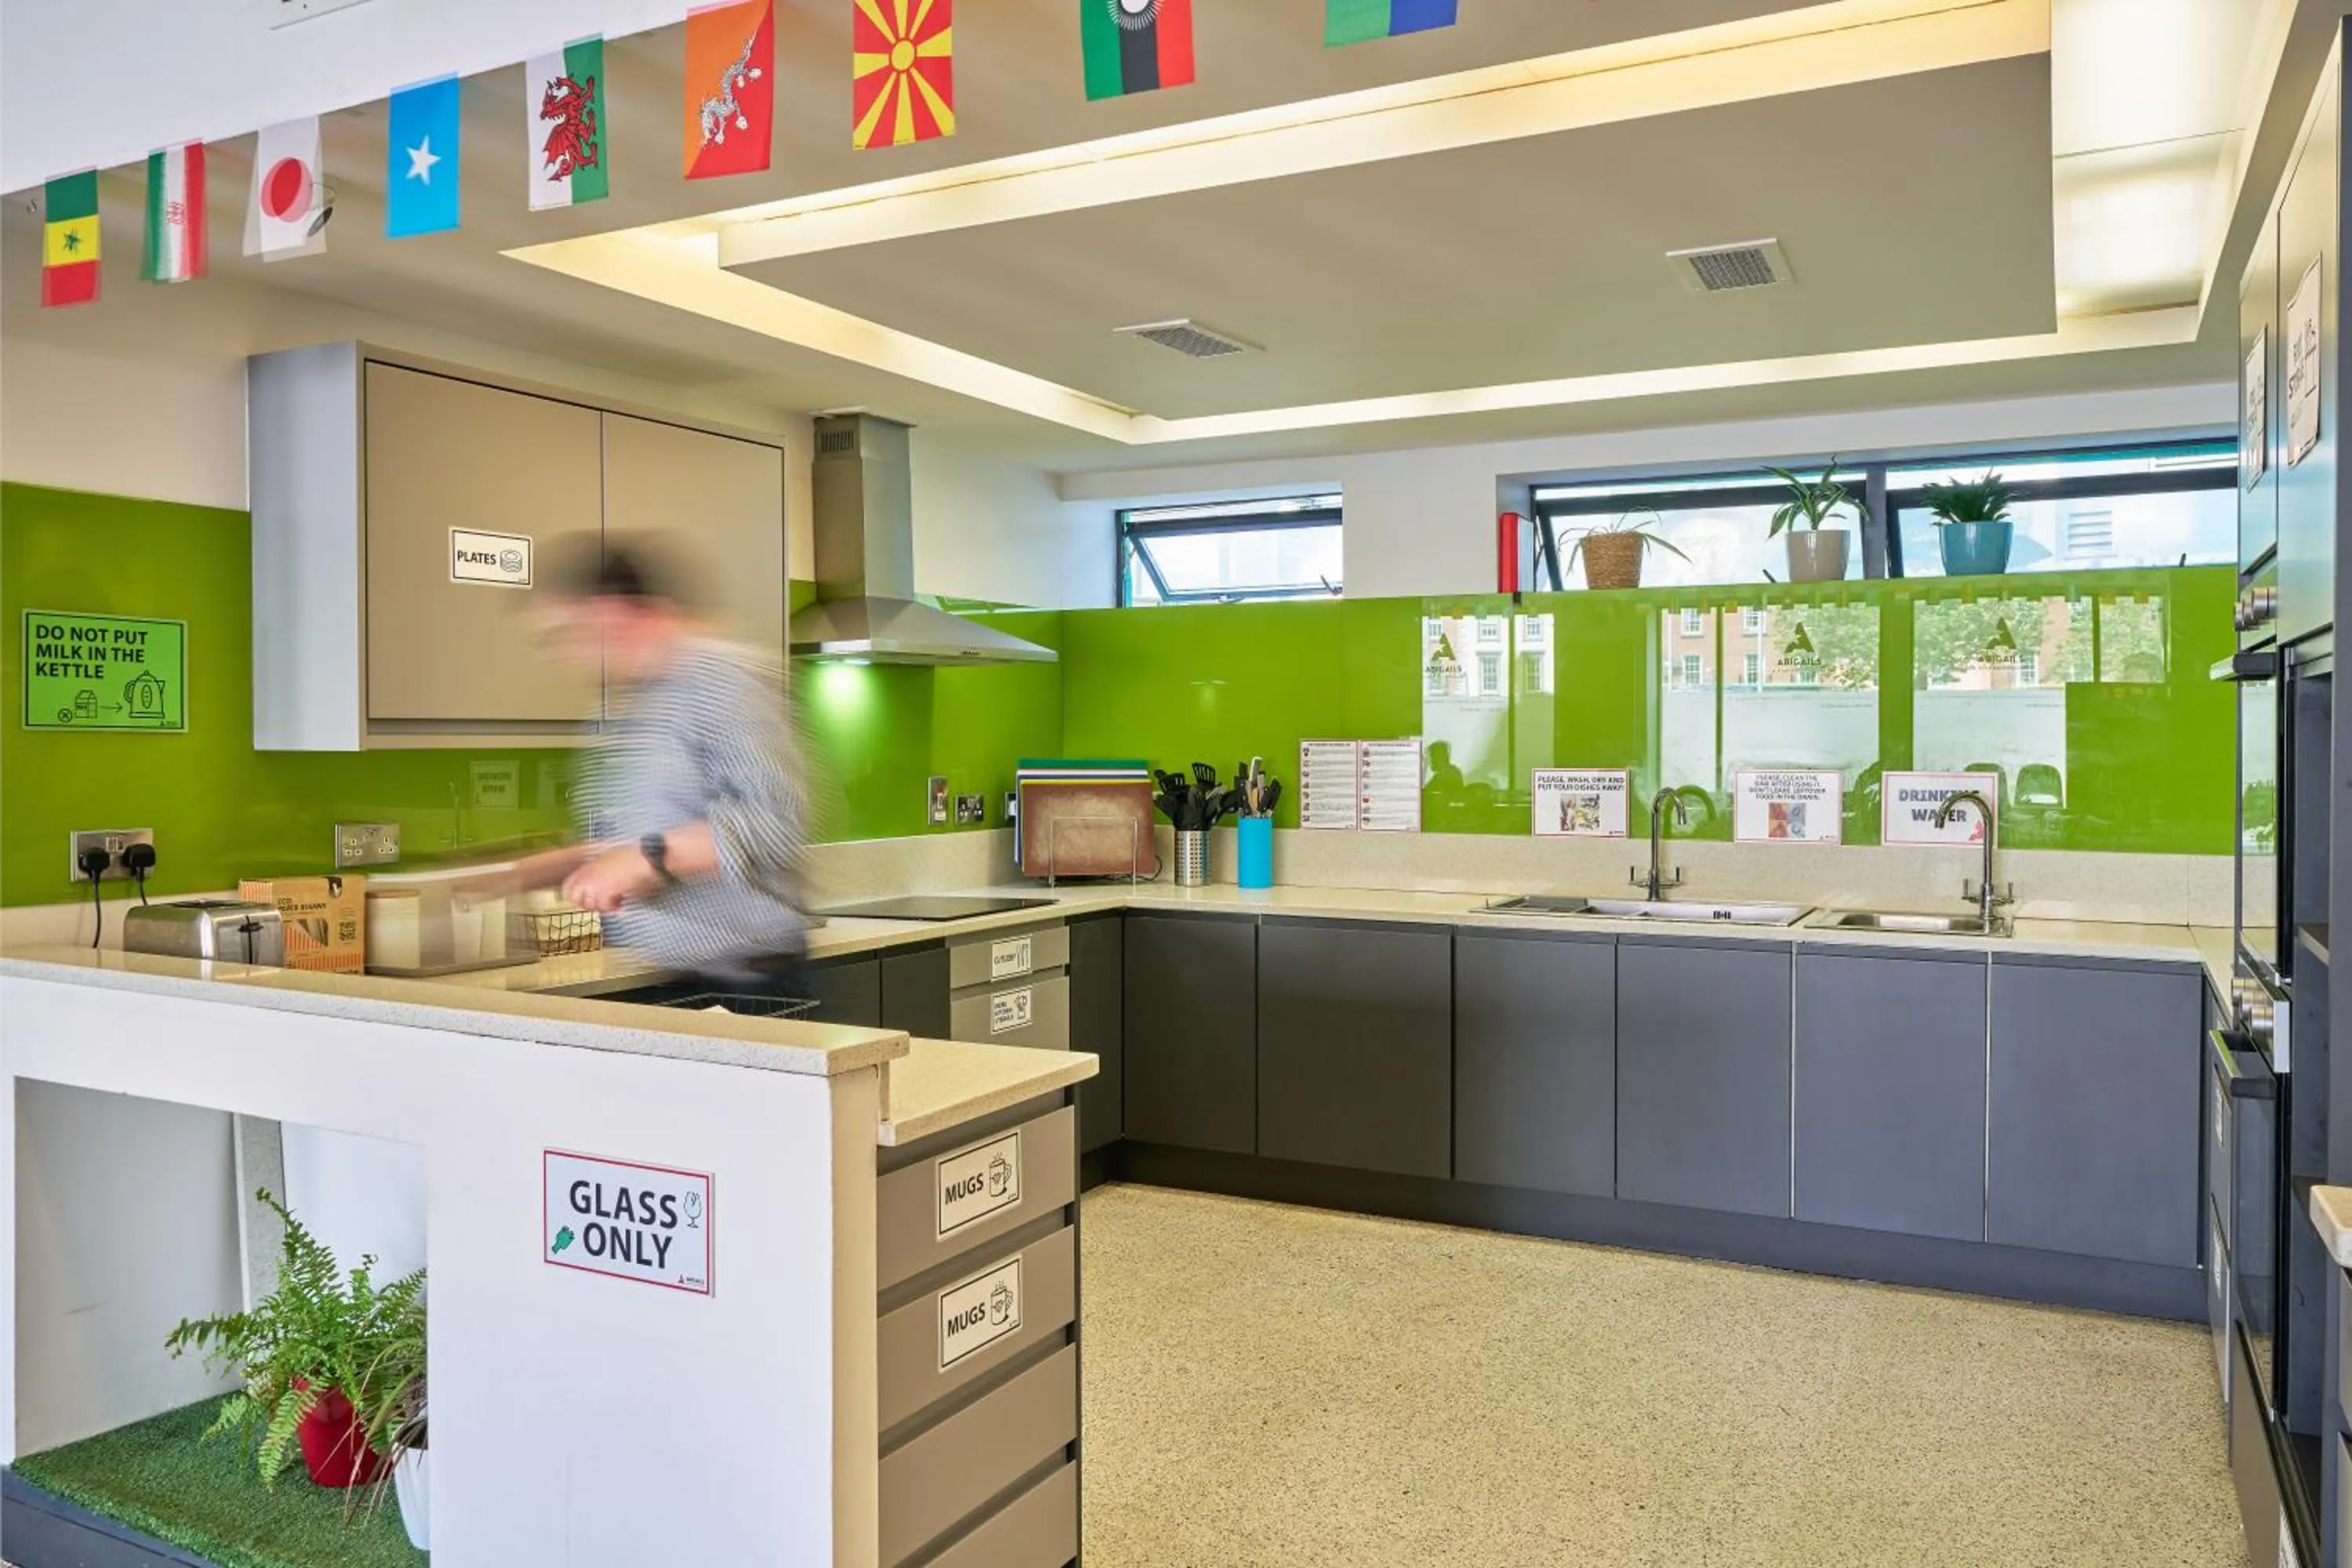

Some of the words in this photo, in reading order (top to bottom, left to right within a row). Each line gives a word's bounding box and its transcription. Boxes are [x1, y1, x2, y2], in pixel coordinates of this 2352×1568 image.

[457, 550, 496, 565] PLATES
[36, 625, 64, 640] DO
[71, 626, 108, 643] NOT
[114, 630, 147, 645] PUT
[36, 644, 82, 659] MILK
[89, 647, 106, 661] IN
[111, 648, 145, 662] THE
[36, 662, 104, 678] KETTLE
[945, 1173, 984, 1204] MUGS
[569, 1180, 678, 1229] GLASS
[583, 1222, 673, 1269] ONLY
[947, 1302, 985, 1338] MUGS
